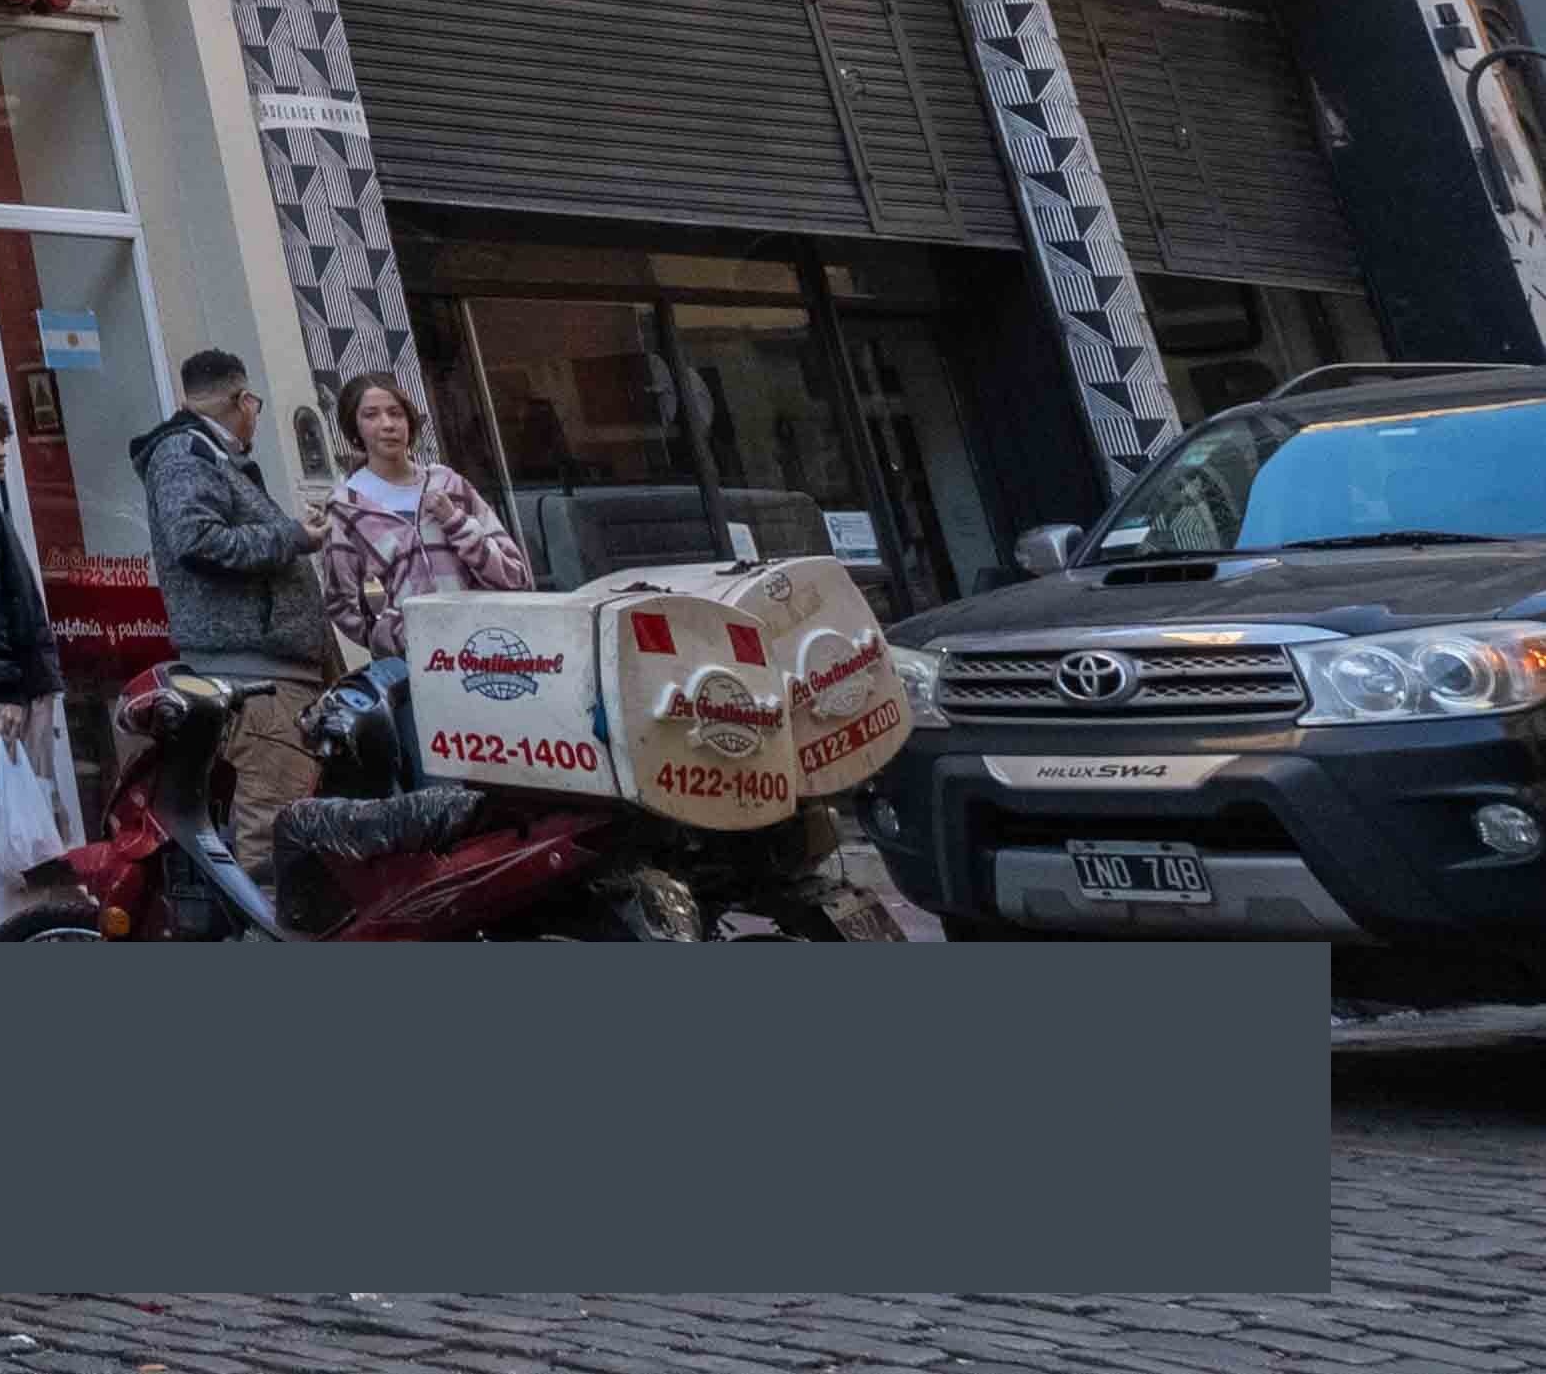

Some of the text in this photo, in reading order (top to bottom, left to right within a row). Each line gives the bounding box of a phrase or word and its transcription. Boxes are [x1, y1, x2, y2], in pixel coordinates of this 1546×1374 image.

[424, 648, 564, 674] La Continental
[430, 730, 598, 772] 4122-1400
[803, 703, 900, 770] 4122 1400
[656, 761, 789, 803] 4122-1400
[1036, 763, 1168, 779] HILUX SW4
[1142, 856, 1203, 890] 748
